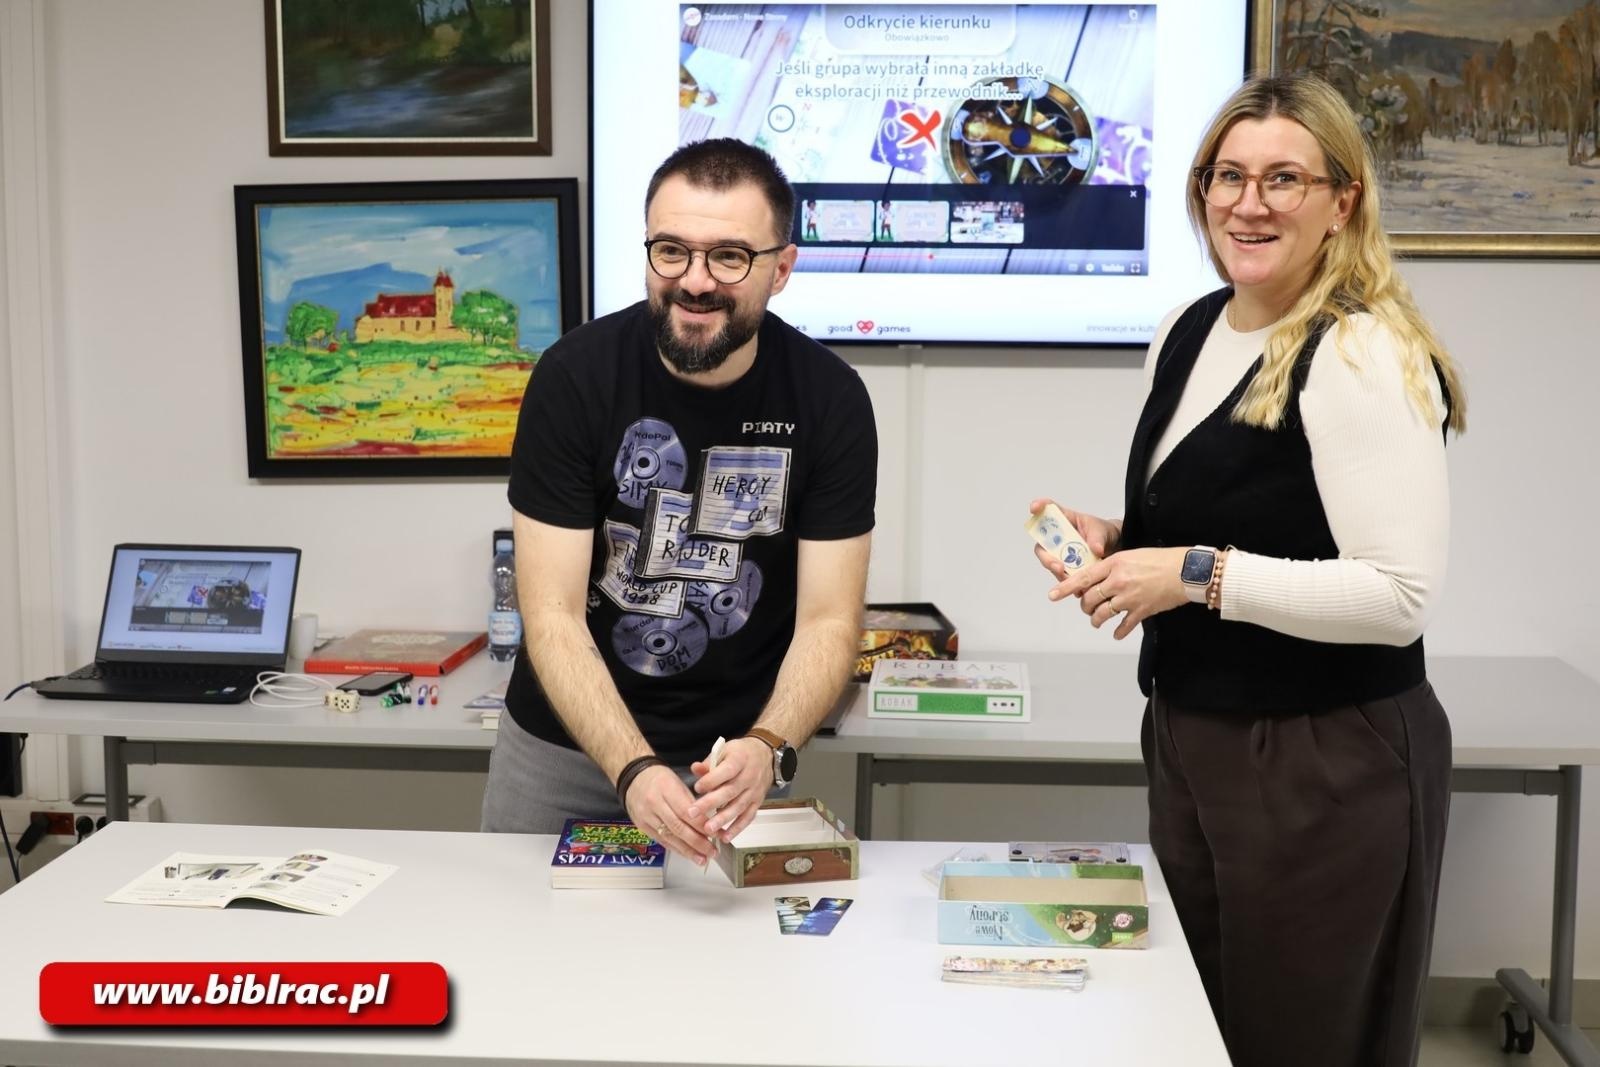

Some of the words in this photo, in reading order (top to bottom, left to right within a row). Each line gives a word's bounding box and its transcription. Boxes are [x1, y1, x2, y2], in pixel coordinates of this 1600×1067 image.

[843, 14, 916, 33] Odkrycie
[920, 14, 991, 29] kierunku
[884, 32, 950, 43] Obowiązkowo
[775, 61, 812, 77] Jeśli
[815, 64, 861, 81] grupa
[863, 61, 929, 80] wybrała
[933, 61, 968, 79] inną
[972, 61, 1045, 79] zakładkę
[794, 84, 882, 104] eksploracji
[885, 84, 909, 98] niż
[827, 324, 853, 335] good
[876, 325, 911, 336] games
[616, 566, 648, 592] WORLD
[652, 582, 678, 594] CUP
[558, 853, 605, 865] LUCAS
[610, 854, 657, 865] MATT
[969, 904, 1010, 923] strony
